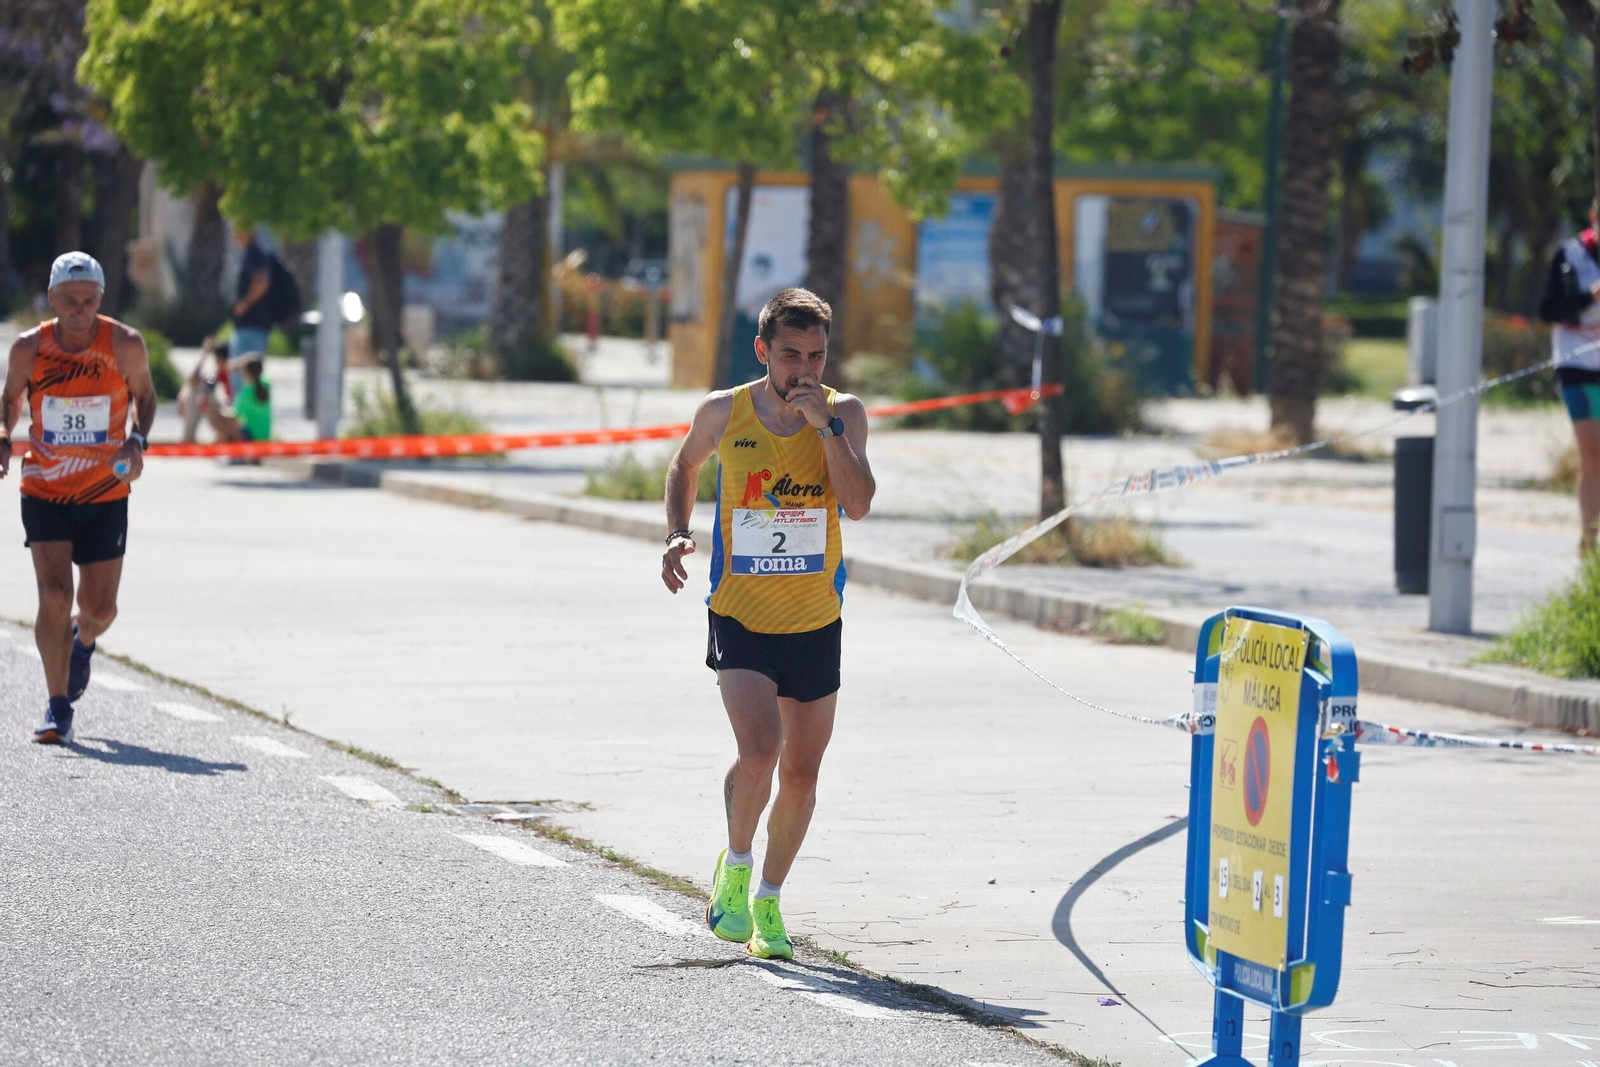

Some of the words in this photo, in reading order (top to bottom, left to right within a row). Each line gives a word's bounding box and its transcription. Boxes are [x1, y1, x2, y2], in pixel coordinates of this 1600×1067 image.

[62, 414, 86, 430] 38
[772, 473, 825, 497] Álora
[771, 531, 787, 554] 2
[1233, 634, 1267, 668] POLICÍA
[1268, 642, 1300, 673] LOCAL
[1243, 676, 1281, 712] MÁLAGA
[1235, 830, 1266, 852] ESTACIONAR
[1221, 867, 1227, 887] 15
[1255, 881, 1260, 901] 2
[1275, 885, 1280, 906] 3
